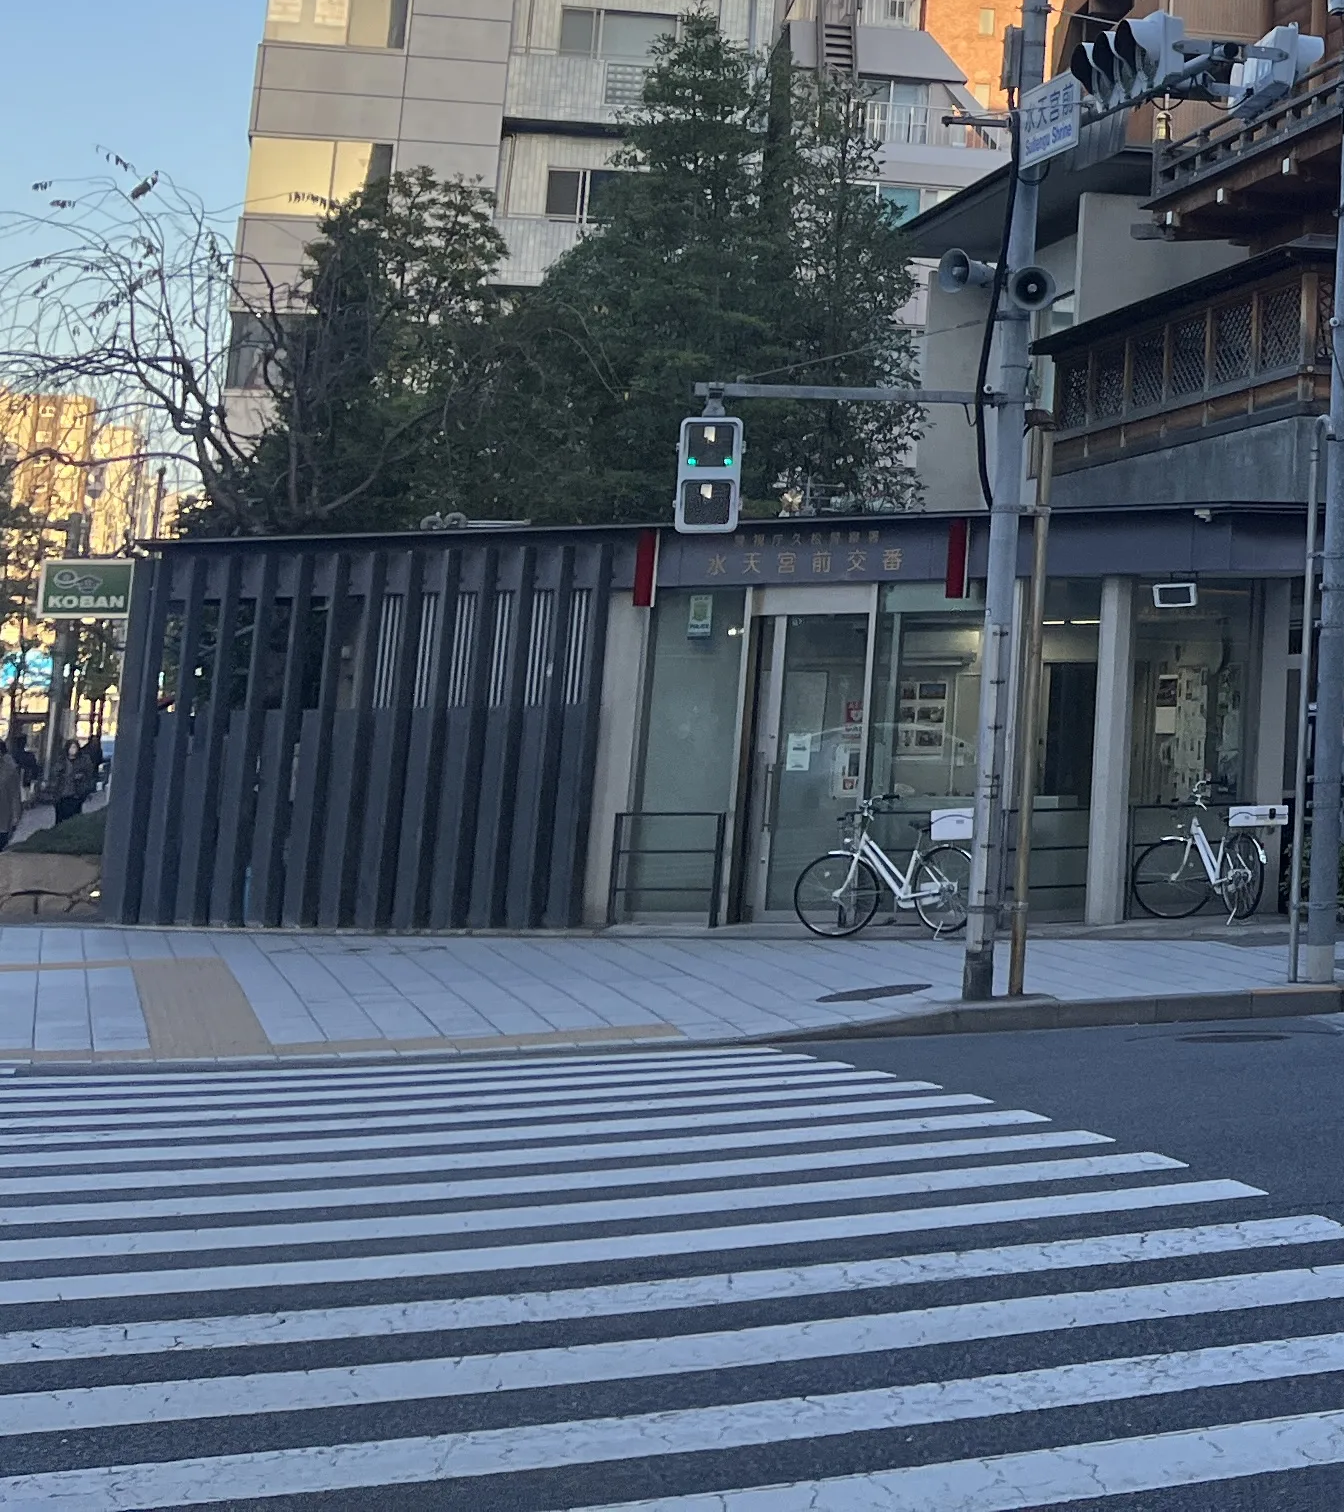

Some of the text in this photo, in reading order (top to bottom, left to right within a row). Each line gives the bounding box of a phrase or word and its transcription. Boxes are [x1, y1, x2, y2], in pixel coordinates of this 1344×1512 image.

[1024, 83, 1074, 134] 水天宮前
[707, 548, 903, 577] 水天宮前交番
[48, 595, 125, 609] KOBAN
